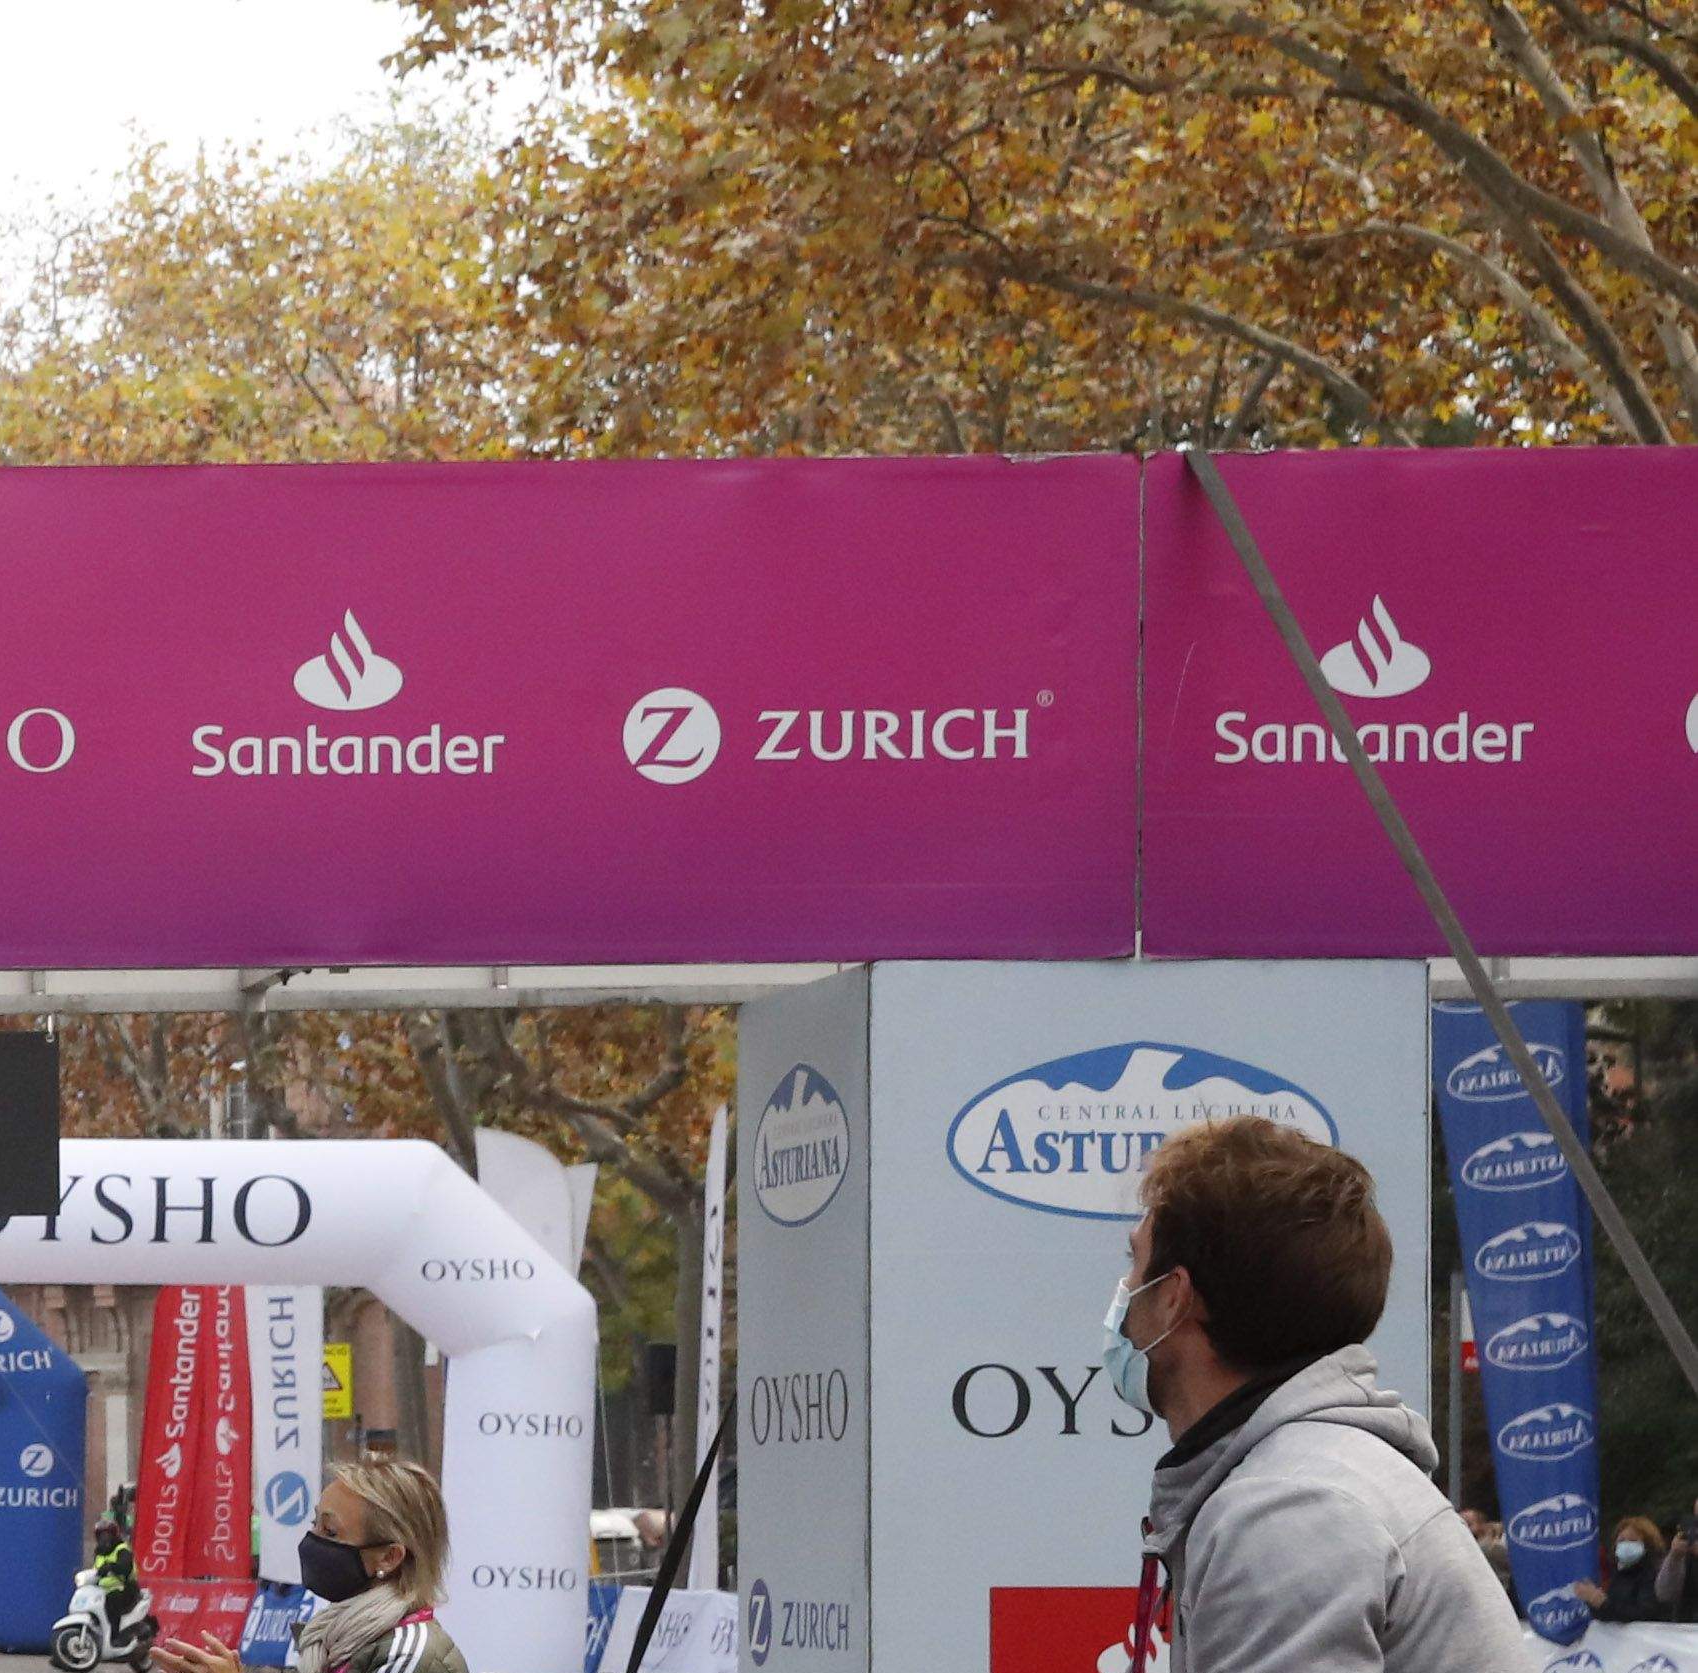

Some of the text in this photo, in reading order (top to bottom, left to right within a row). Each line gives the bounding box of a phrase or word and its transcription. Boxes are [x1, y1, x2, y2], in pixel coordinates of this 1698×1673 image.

[191, 723, 506, 777] Santander
[756, 708, 1030, 762] ZURICH
[1037, 1103, 1161, 1122] CENTRAL
[759, 1127, 841, 1191] ASTURIANA
[420, 1257, 535, 1283] OYSHO
[142, 1286, 201, 1573] Sports Santander
[477, 1411, 584, 1439] OYSHO
[750, 1367, 849, 1446] OYSHO
[471, 1563, 577, 1591] OYSHO
[781, 1600, 851, 1653] ZURICH
